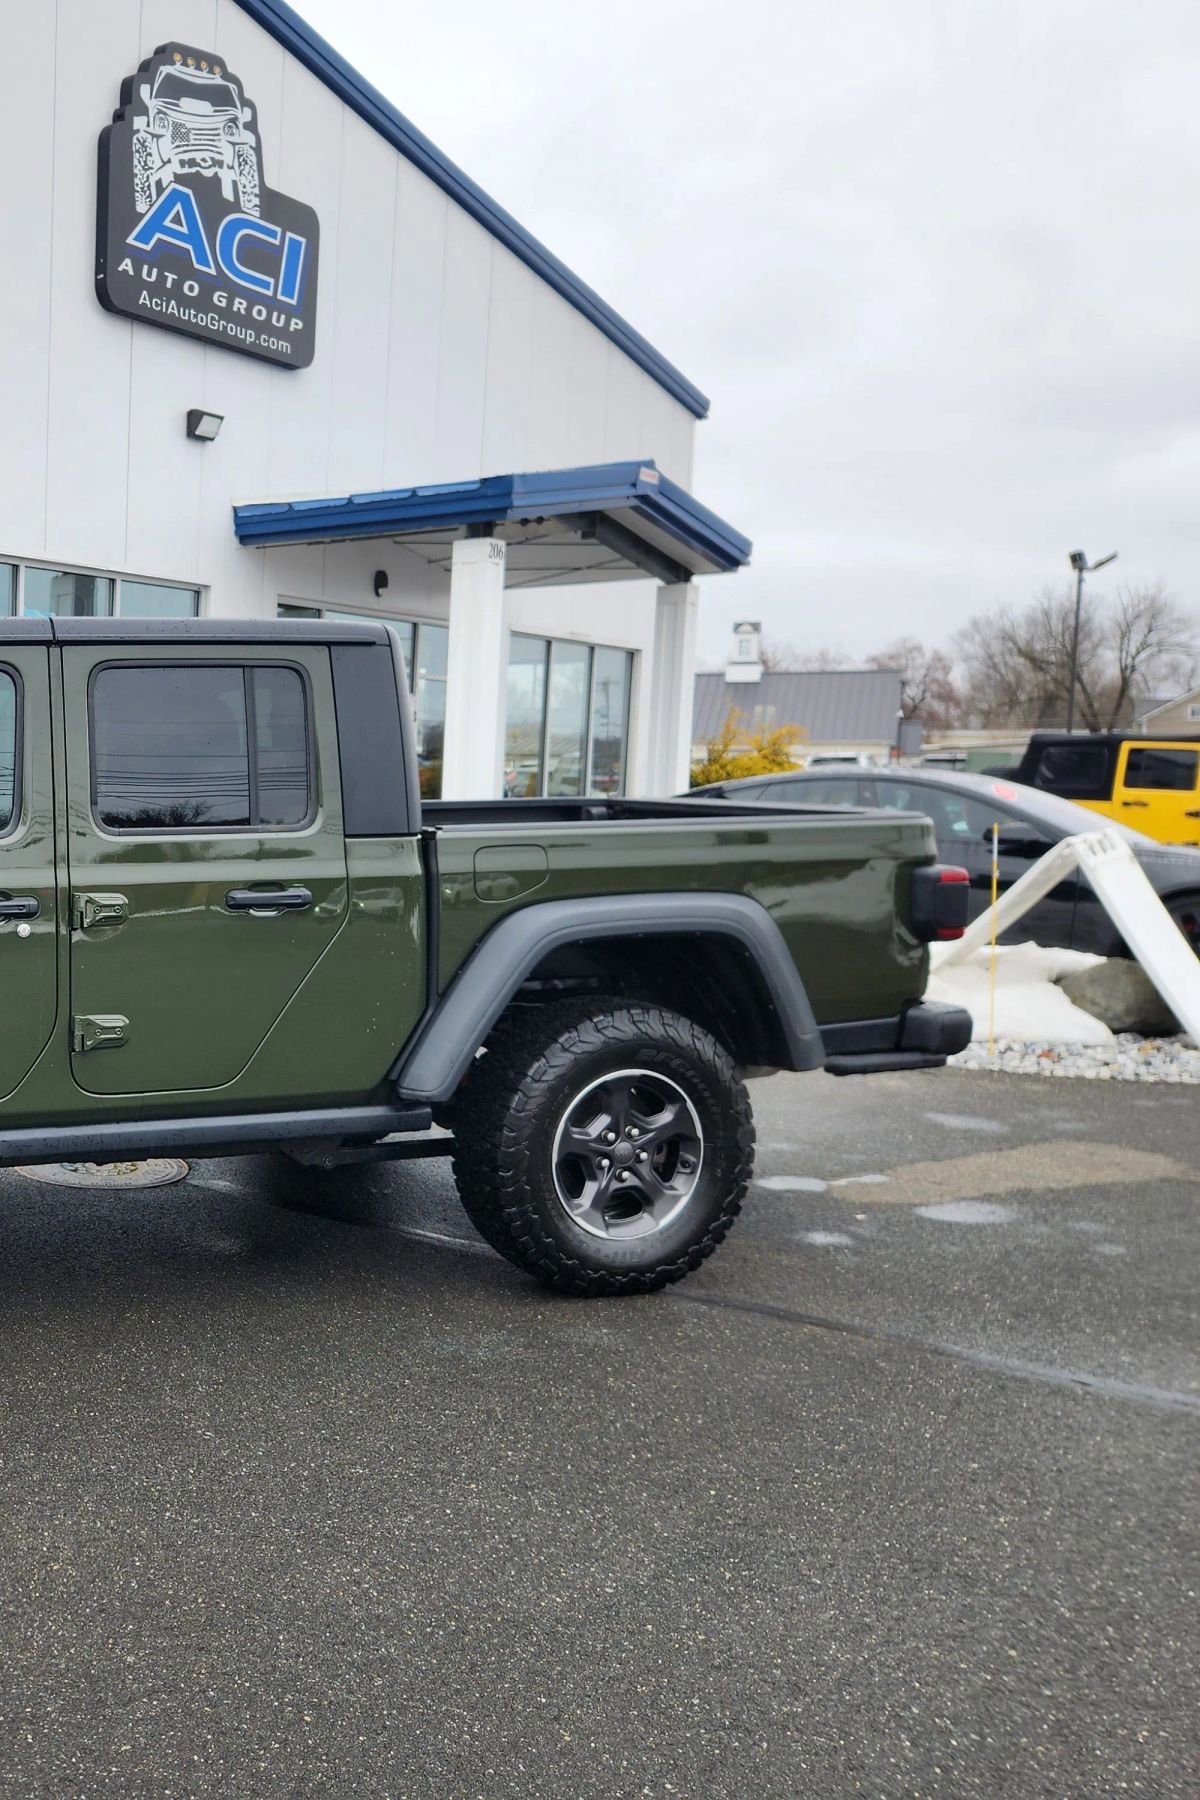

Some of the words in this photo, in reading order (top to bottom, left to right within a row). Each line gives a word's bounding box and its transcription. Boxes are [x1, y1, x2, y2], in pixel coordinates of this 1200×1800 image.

[126, 182, 306, 305] ACI
[117, 257, 199, 297] AUTO
[212, 290, 304, 333] GROUP
[138, 289, 292, 355] AciAutoGroup.com
[488, 542, 504, 560] 206
